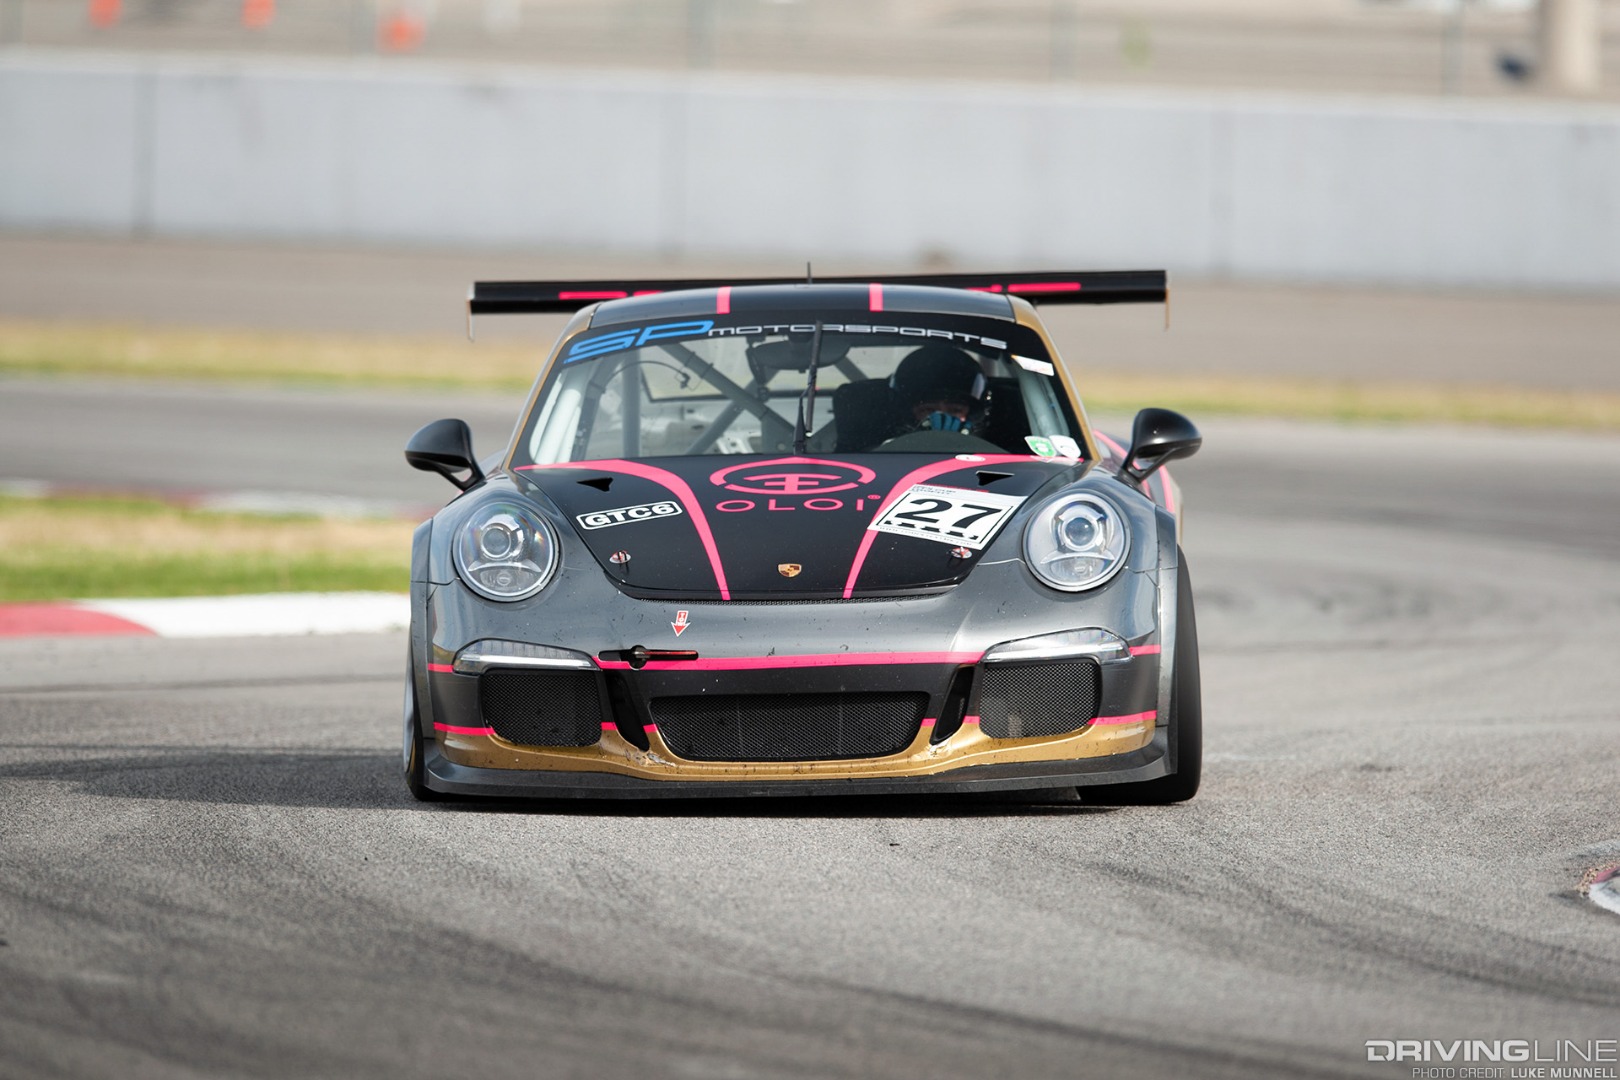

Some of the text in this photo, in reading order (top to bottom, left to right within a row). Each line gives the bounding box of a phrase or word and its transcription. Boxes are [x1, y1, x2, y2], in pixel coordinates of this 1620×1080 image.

[563, 319, 1007, 365] SP MOTORSPORTS
[584, 502, 676, 528] GTC6
[894, 498, 1003, 529] 27
